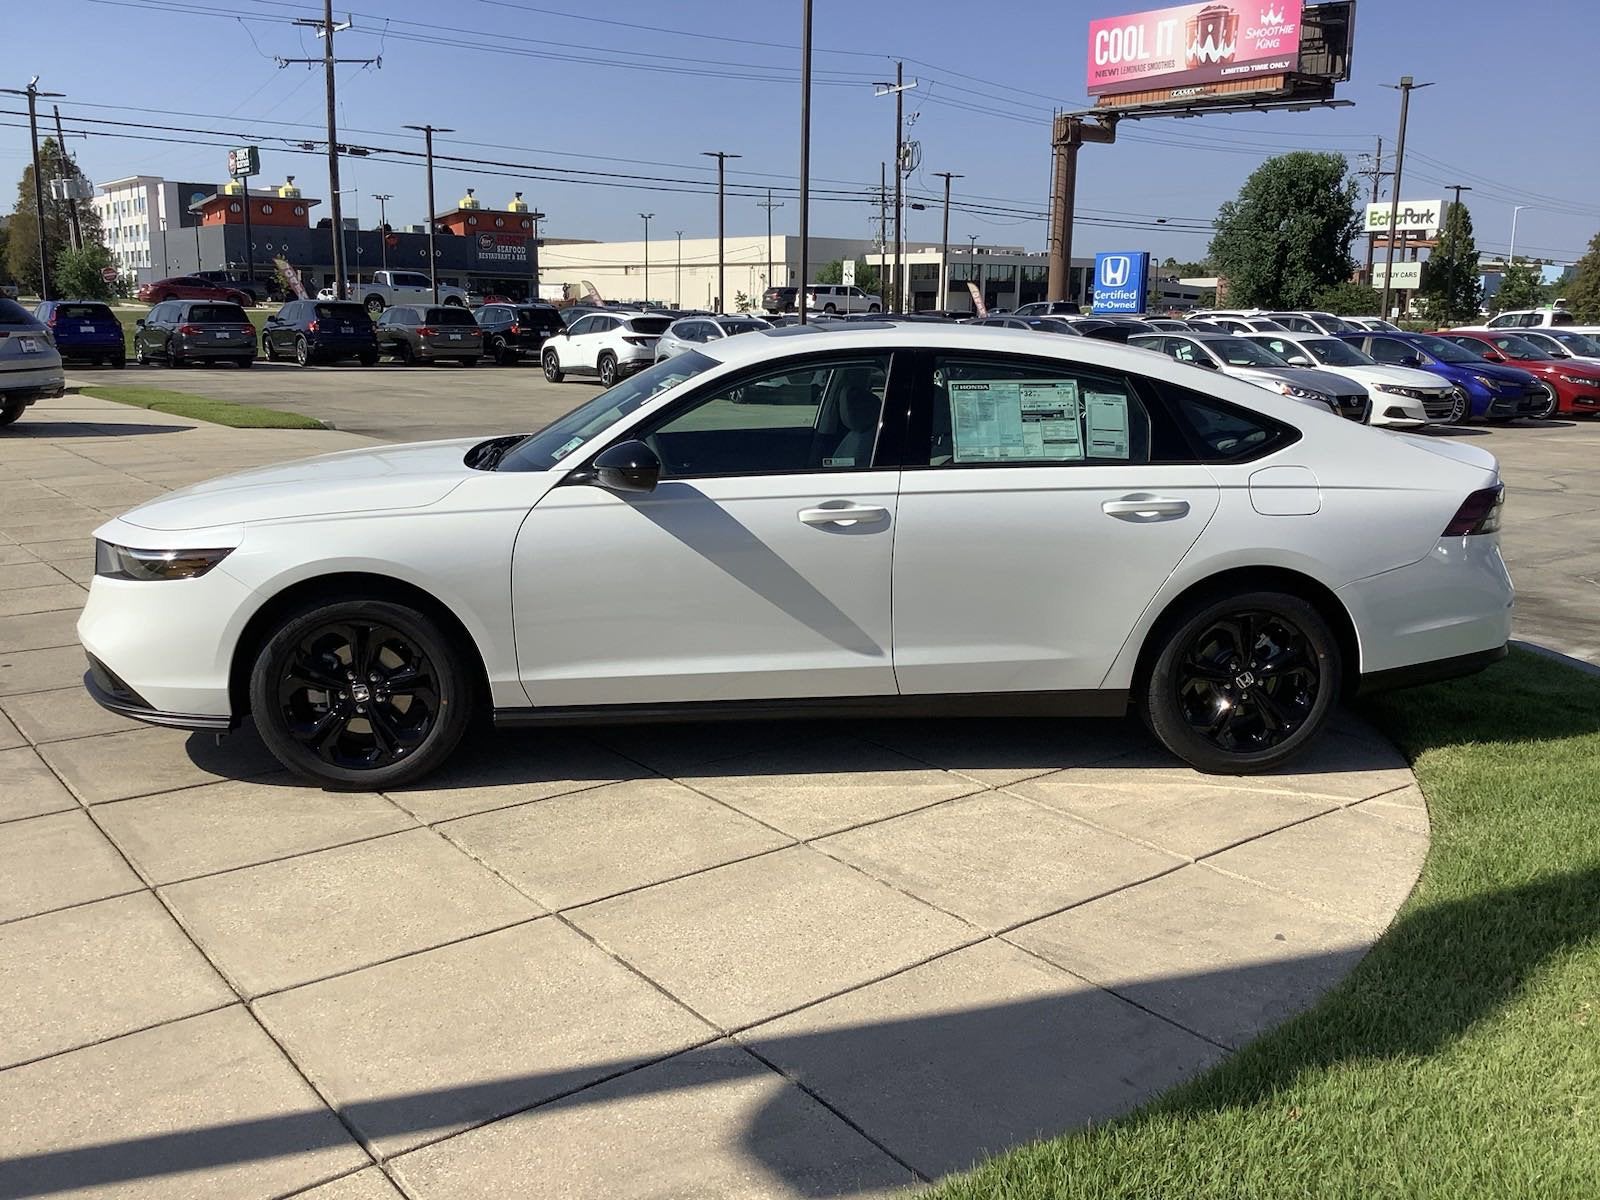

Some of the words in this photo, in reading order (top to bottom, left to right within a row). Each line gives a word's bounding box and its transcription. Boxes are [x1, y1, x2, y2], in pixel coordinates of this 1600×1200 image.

[1245, 24, 1296, 40] SMOOTHIE
[1095, 24, 1150, 66] COOL
[1156, 19, 1178, 57] IT
[1120, 64, 1147, 75] LEMONADE
[1147, 59, 1176, 72] SMOOTHIES
[1220, 65, 1250, 76] LIMITED
[1250, 63, 1269, 73] TIME
[1269, 60, 1291, 70] ONLY
[1370, 208, 1435, 226] EchoPark
[497, 245, 526, 254] SEAFOOD
[1095, 290, 1136, 300] Certified
[1094, 301, 1136, 309] Pre-Owned
